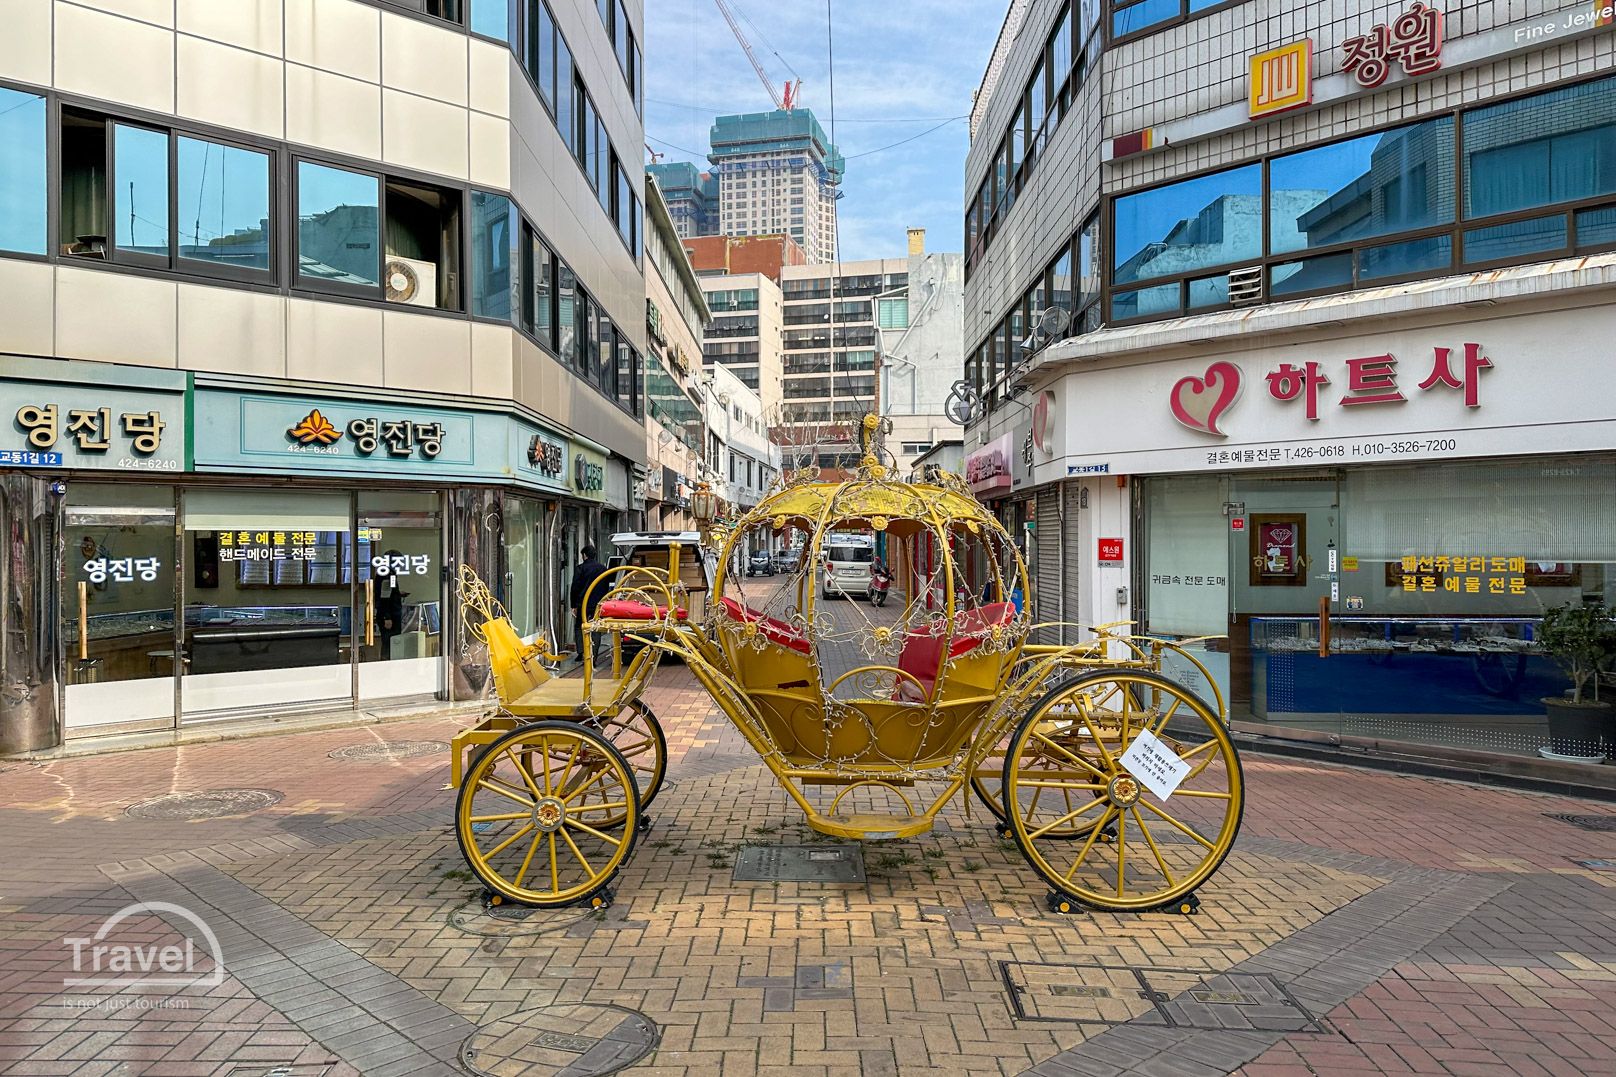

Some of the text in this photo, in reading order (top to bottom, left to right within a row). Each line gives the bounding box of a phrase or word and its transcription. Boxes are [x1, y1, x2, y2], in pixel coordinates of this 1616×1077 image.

[1514, 23, 1555, 42] Fine
[1339, 1, 1442, 88] 정원
[1265, 343, 1494, 420] 하트사
[17, 404, 165, 452] 영진당
[349, 418, 446, 456] 영진당
[0, 452, 56, 464] 교동1길 12
[1284, 446, 1345, 461] T.426-0618
[1352, 439, 1456, 456] H.010-3526-7200
[118, 458, 176, 469] 424-6240
[291, 532, 316, 545] 전문
[219, 547, 316, 561] 핸드메이드 전문
[1102, 546, 1120, 554] 에스원
[83, 557, 160, 583] 영진당
[372, 554, 430, 576] 영진당
[1490, 556, 1526, 573] 도매
[1152, 574, 1226, 586] 귀금속 전문 도매
[1488, 577, 1527, 594] 전문
